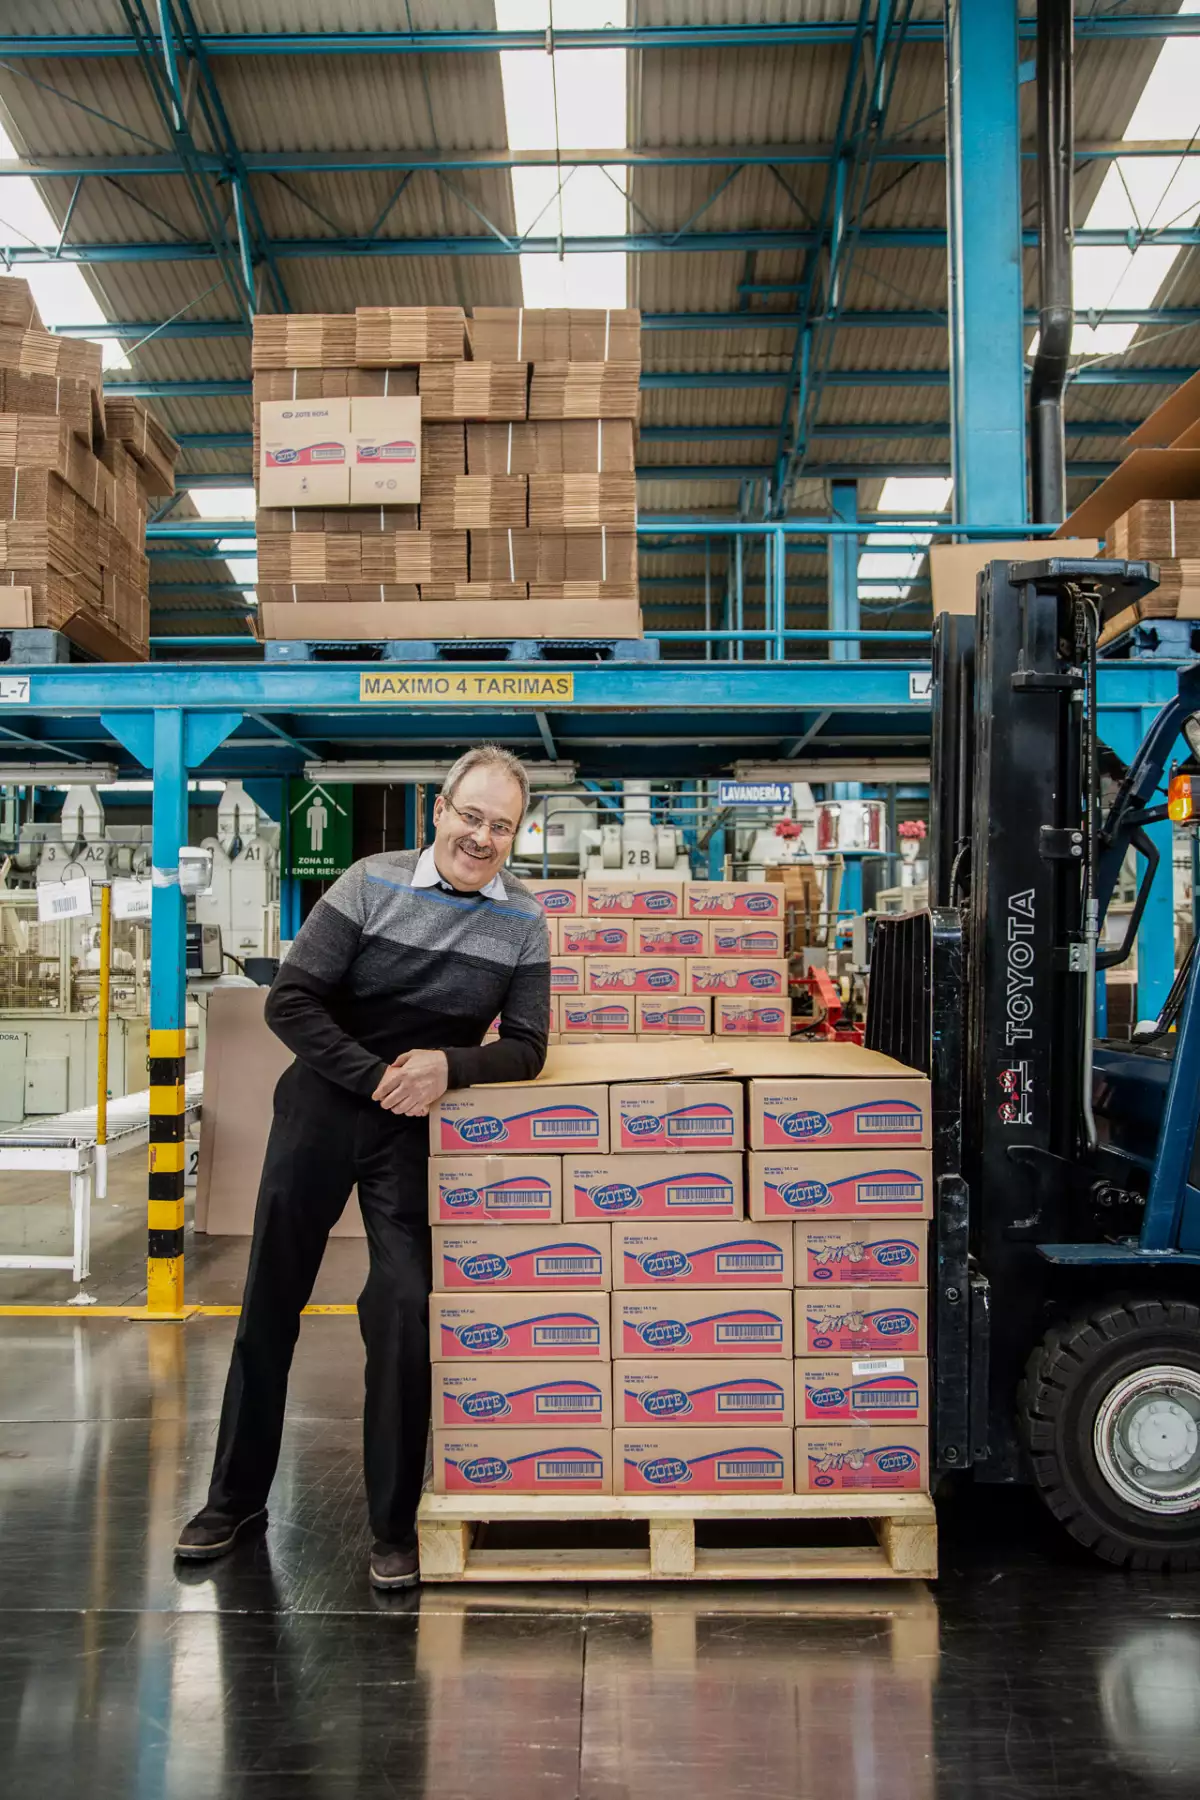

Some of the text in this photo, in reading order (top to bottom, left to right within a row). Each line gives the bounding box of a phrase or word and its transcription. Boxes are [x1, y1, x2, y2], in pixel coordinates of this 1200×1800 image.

[364, 677, 569, 694] MAXIMO 4 TARIMAS
[721, 783, 790, 801] LAVANDERÍA 2
[48, 847, 56, 861] 3
[85, 847, 104, 861] A2
[244, 845, 261, 861] A1
[298, 857, 322, 865] ZONA
[628, 850, 650, 864] 2 B
[285, 867, 315, 875] ENOR
[1005, 888, 1035, 1046] TOYOTA
[464, 1121, 499, 1138] ZOTE
[631, 1119, 657, 1131] ZOTE
[787, 1116, 822, 1133] ZOTE
[188, 1150, 199, 1175] 2
[449, 1191, 475, 1204] ZOTE
[598, 1188, 633, 1205] ZOTE
[788, 1185, 823, 1202] ZOTE
[647, 1255, 682, 1272] ZOTE
[880, 1249, 908, 1262] ZOTE
[467, 1259, 502, 1275] ZOTE
[647, 1324, 681, 1341] ZOTE
[880, 1318, 907, 1331] ZOTE
[464, 1328, 499, 1344] ZOTE
[467, 1396, 501, 1412] ZOTE
[648, 1393, 683, 1410] ZOTE
[815, 1392, 841, 1403] ZOTE
[468, 1462, 503, 1478] ZOTE
[881, 1456, 909, 1468] ZOTE
[648, 1462, 683, 1479] ZOTE
